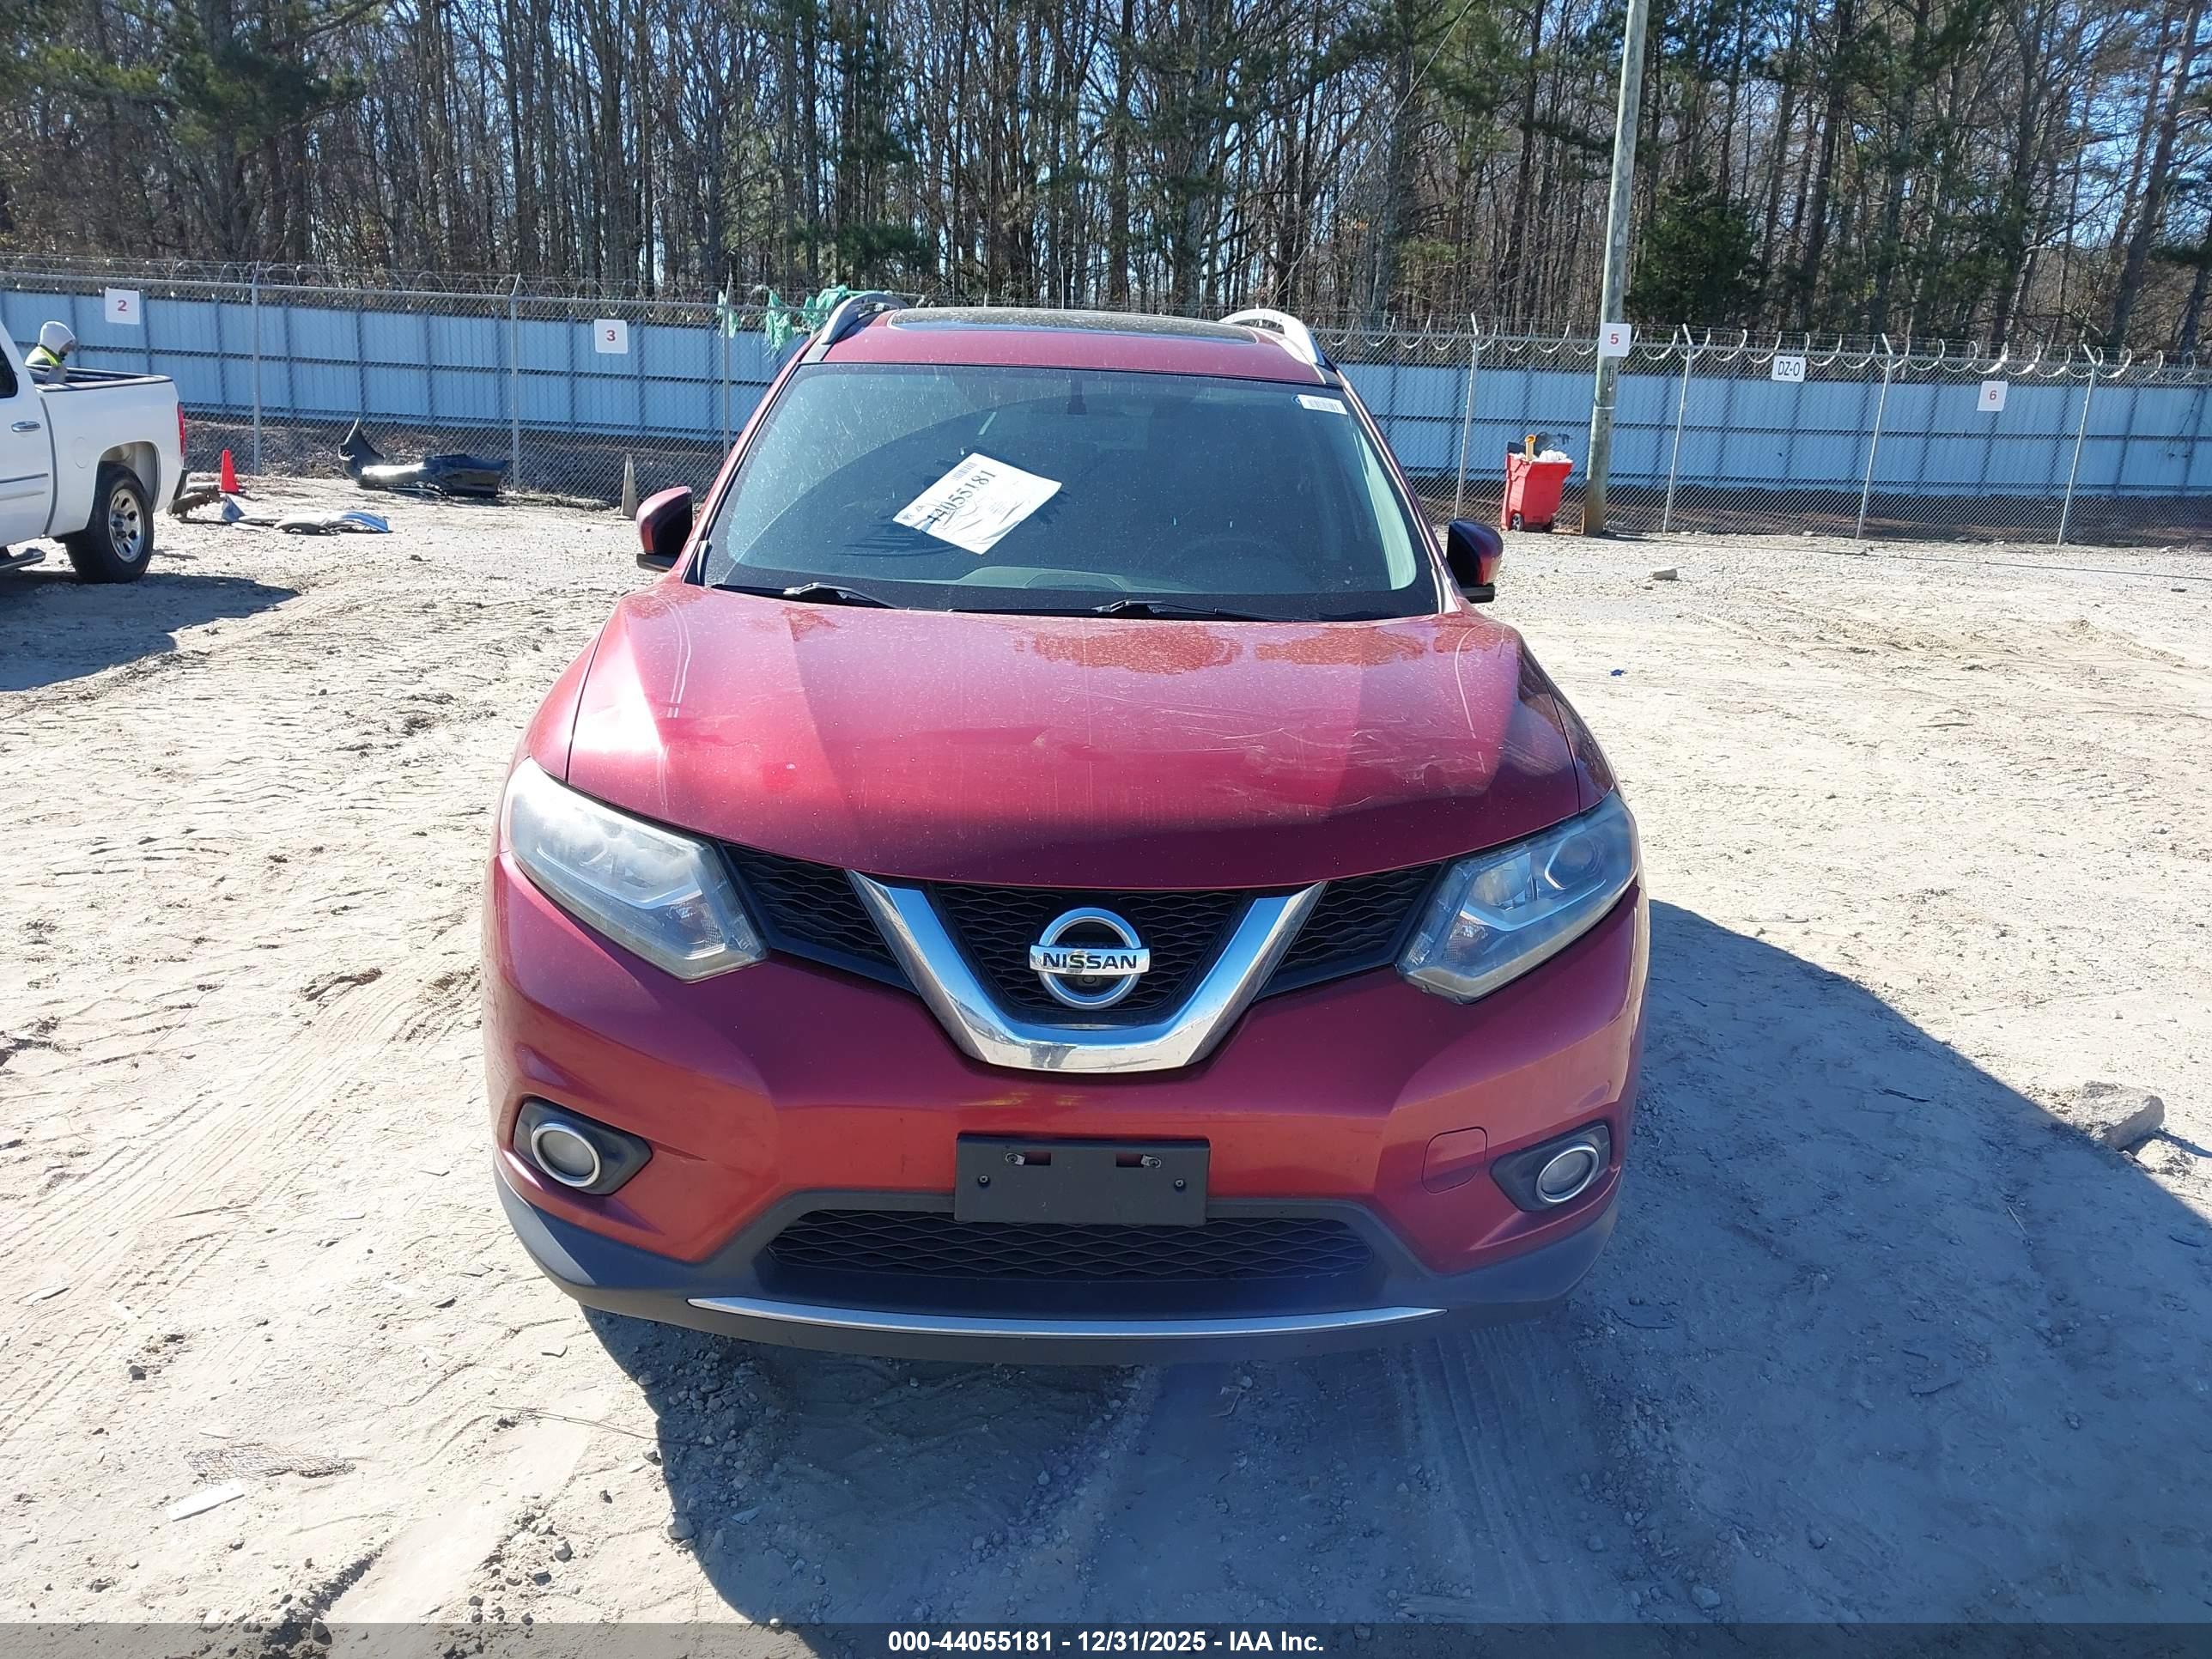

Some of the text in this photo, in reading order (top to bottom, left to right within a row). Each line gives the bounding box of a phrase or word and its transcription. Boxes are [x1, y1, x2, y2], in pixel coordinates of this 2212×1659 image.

[117, 299, 128, 312] 2
[605, 329, 617, 342] 3
[1609, 332, 1620, 345] 5
[1989, 389, 1997, 401] 6
[1042, 951, 1138, 969] NISSAN
